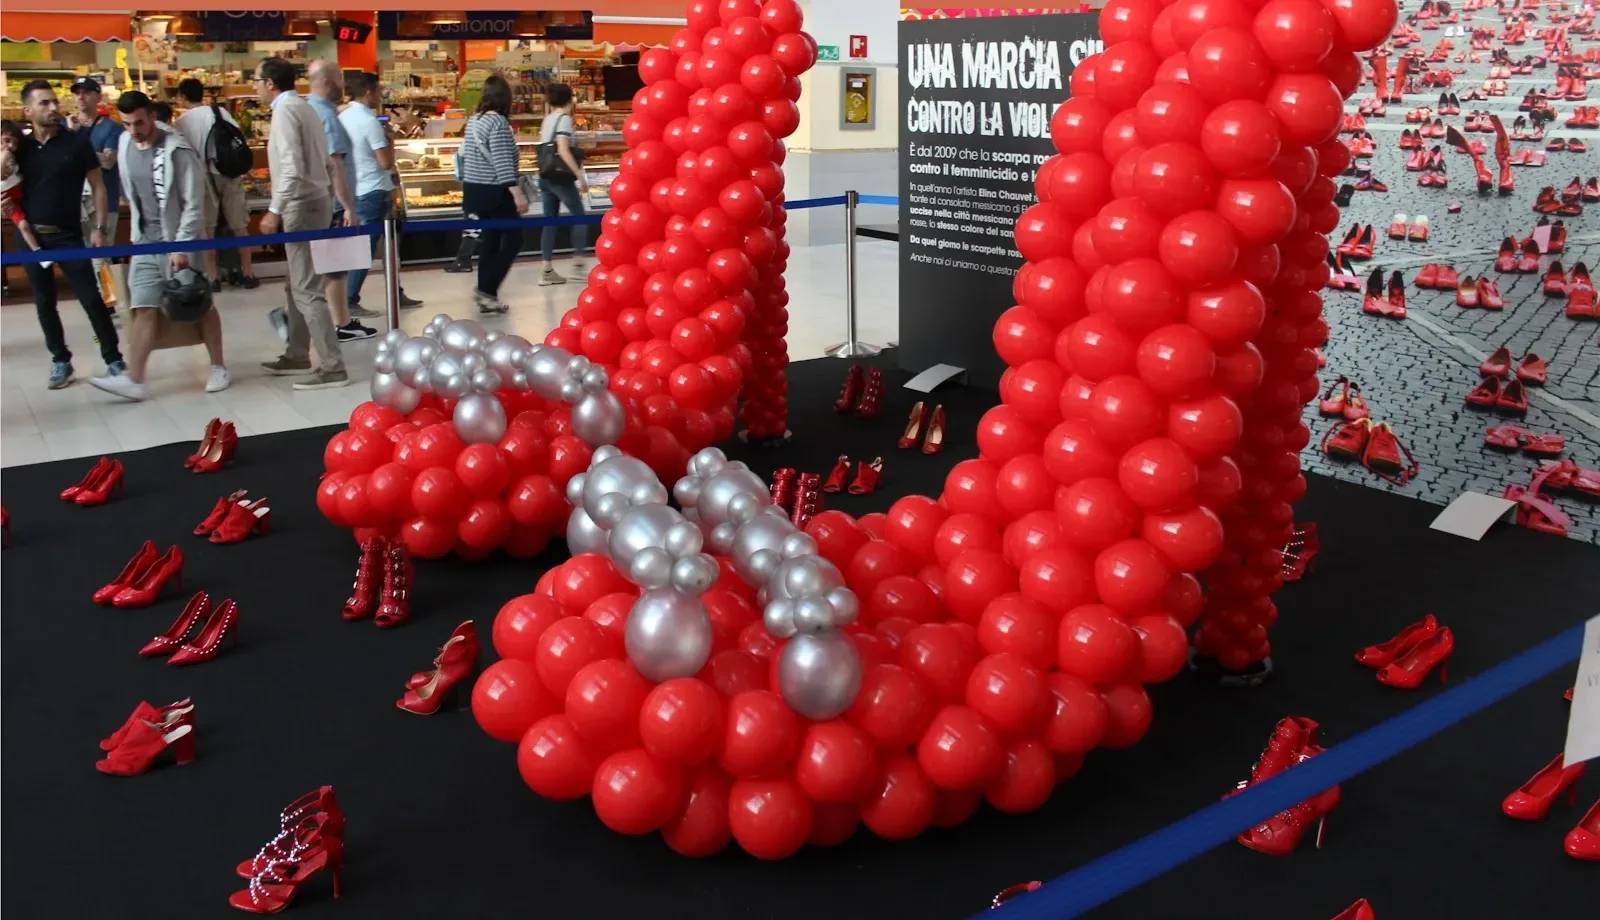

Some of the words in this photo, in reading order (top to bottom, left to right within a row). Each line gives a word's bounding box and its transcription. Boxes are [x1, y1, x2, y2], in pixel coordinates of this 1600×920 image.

[339, 27, 359, 41] 81
[907, 42, 957, 89] UNA
[961, 38, 1063, 89] MARCIA
[907, 98, 975, 135] CONTRO
[980, 101, 1004, 136] LA
[910, 141, 916, 157] È
[917, 145, 932, 158] dal
[934, 145, 957, 159] 2009
[959, 148, 978, 161] che
[980, 149, 990, 161] la
[992, 151, 1031, 166] scarpa
[910, 162, 941, 175] contro
[943, 163, 949, 176] il
[951, 164, 1019, 181] femminicidio
[1021, 171, 1029, 182] e
[910, 181, 916, 191] In
[979, 188, 997, 198] Elina
[999, 190, 1032, 202] Chauvet
[910, 193, 928, 204] fronte
[938, 198, 971, 208] consolato
[972, 201, 1011, 212] messicano
[910, 206, 933, 216] uccise
[934, 208, 952, 218] nella
[953, 210, 971, 221] città
[972, 213, 1013, 225] messicana
[910, 218, 928, 228] rosse,
[929, 219, 936, 229] lo
[937, 220, 960, 231] stesso
[960, 223, 985, 234] colore
[985, 226, 999, 236] del
[1000, 229, 1014, 238] san
[910, 234, 920, 244] Da
[921, 237, 937, 247] quel
[938, 239, 961, 250] giorno
[962, 241, 970, 251] le
[970, 244, 1006, 256] scarpette
[910, 252, 932, 264] Anche
[933, 257, 944, 265] noi
[952, 260, 980, 271] uniamo
[980, 264, 987, 272] a
[987, 265, 1012, 276] questa
